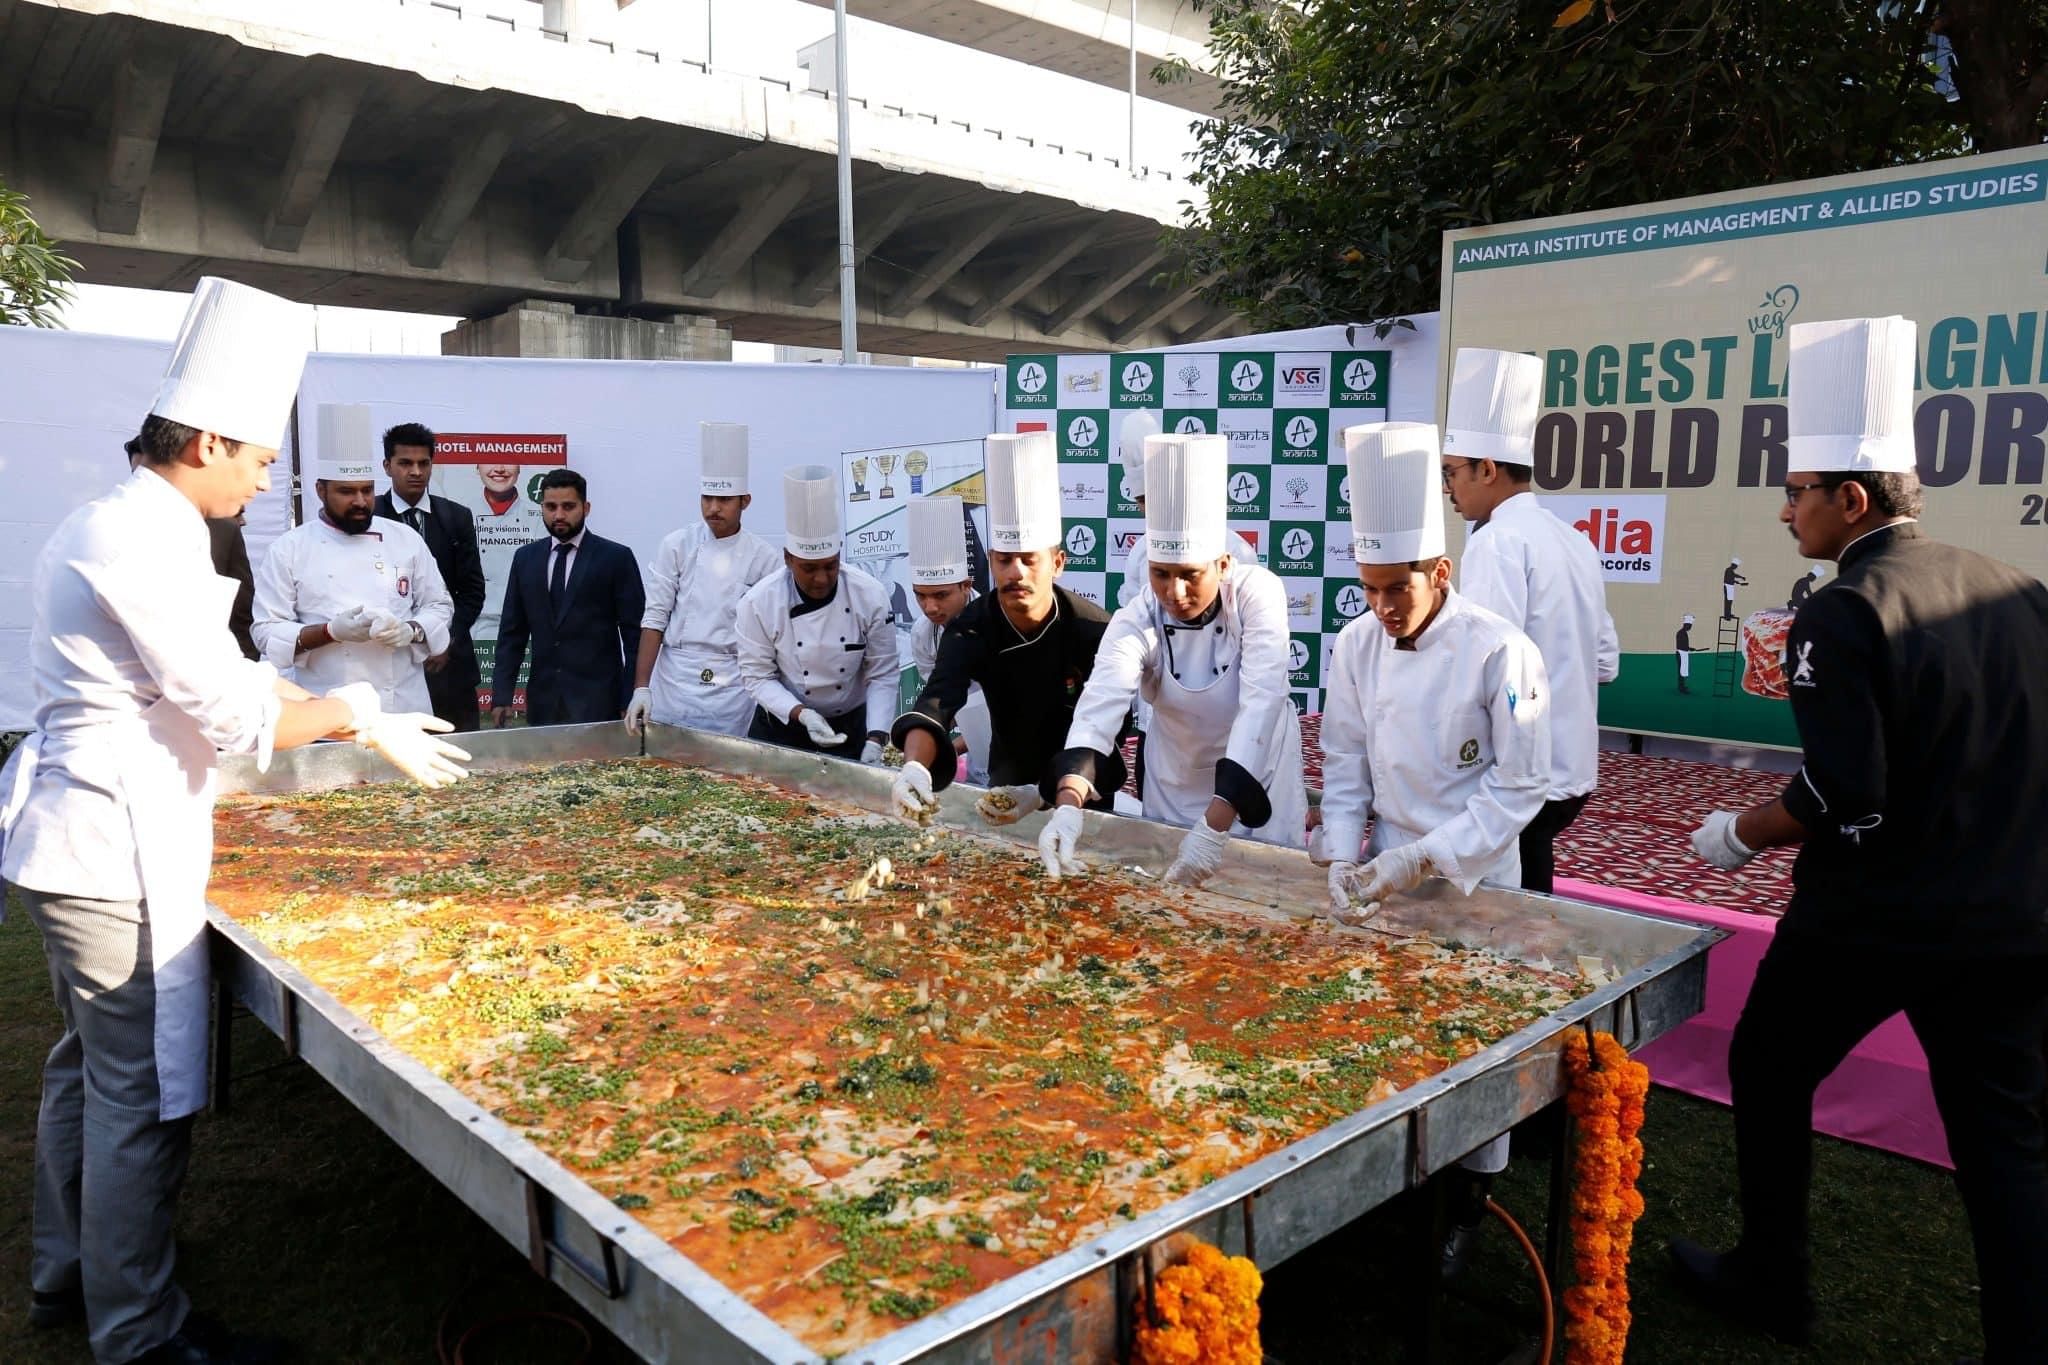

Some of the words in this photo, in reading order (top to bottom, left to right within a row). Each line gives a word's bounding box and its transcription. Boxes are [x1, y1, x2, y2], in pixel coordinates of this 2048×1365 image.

[1458, 242, 1529, 264] ANANTA
[1534, 228, 1627, 255] INSTITUTE
[1632, 225, 1657, 241] OF
[1662, 203, 1813, 239] MANAGEMENT
[1817, 201, 1835, 219] &
[1838, 189, 1921, 217] ALLIED
[1927, 172, 2040, 206] STUDIES
[1281, 367, 1320, 385] VSG
[1525, 336, 1738, 408] RGEST
[1015, 393, 1048, 403] ananta
[1119, 392, 1154, 402] ananta
[1228, 391, 1264, 402] ananta
[1340, 390, 1376, 401] ananta
[434, 442, 472, 453] HOTEL
[475, 443, 565, 454] MANAGEMENT
[1065, 447, 1100, 457] ananta
[1282, 448, 1318, 458] ananta
[1533, 407, 1720, 491] ORLD
[476, 524, 494, 534] ding
[495, 524, 521, 533] visions
[522, 524, 530, 533] in
[1573, 508, 1653, 555] dia
[480, 537, 537, 546] MANAGEMEN
[858, 529, 896, 544] STUDY
[1354, 535, 1381, 550] nta
[853, 543, 902, 556] HOSPITALITY
[1600, 557, 1652, 571] cords
[1288, 671, 1310, 681] anta
